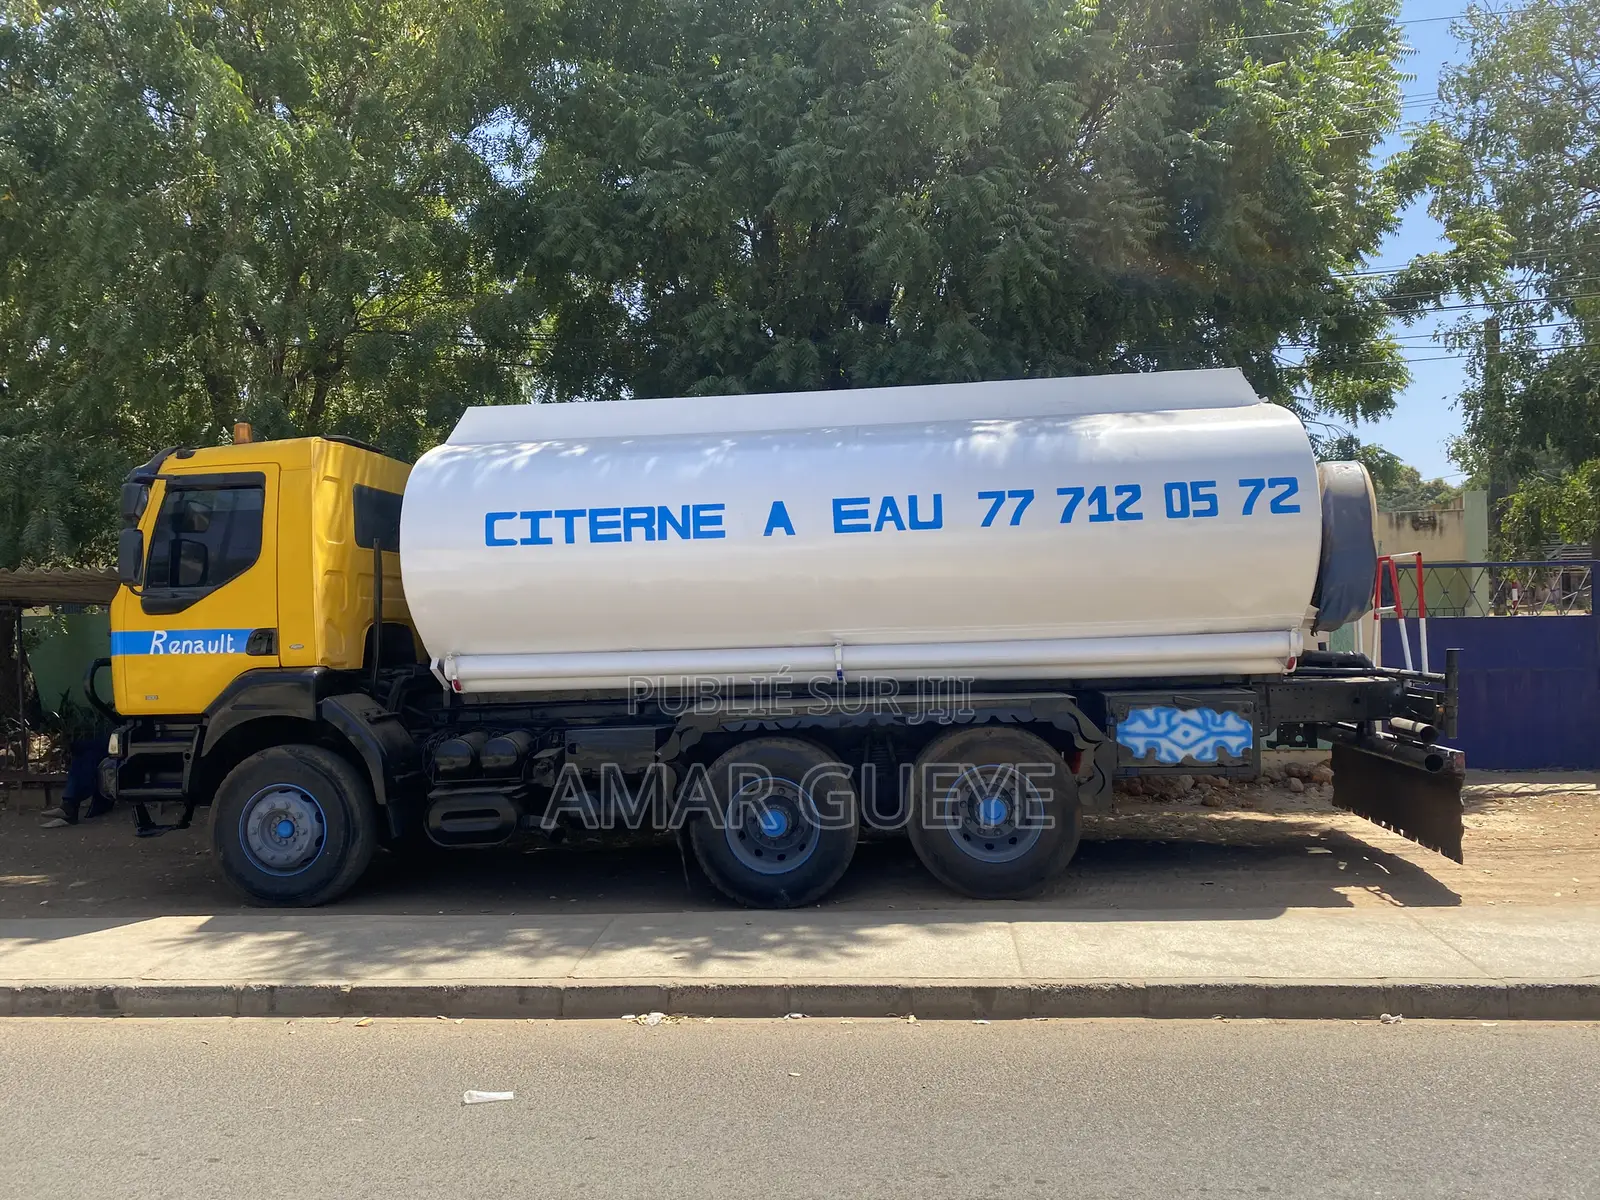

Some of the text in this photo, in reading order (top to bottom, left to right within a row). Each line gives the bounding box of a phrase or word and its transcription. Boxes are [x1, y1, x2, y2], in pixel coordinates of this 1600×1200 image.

[485, 476, 1301, 546] CITERNE A EAU 77 712 05 72
[150, 630, 236, 655] Renault
